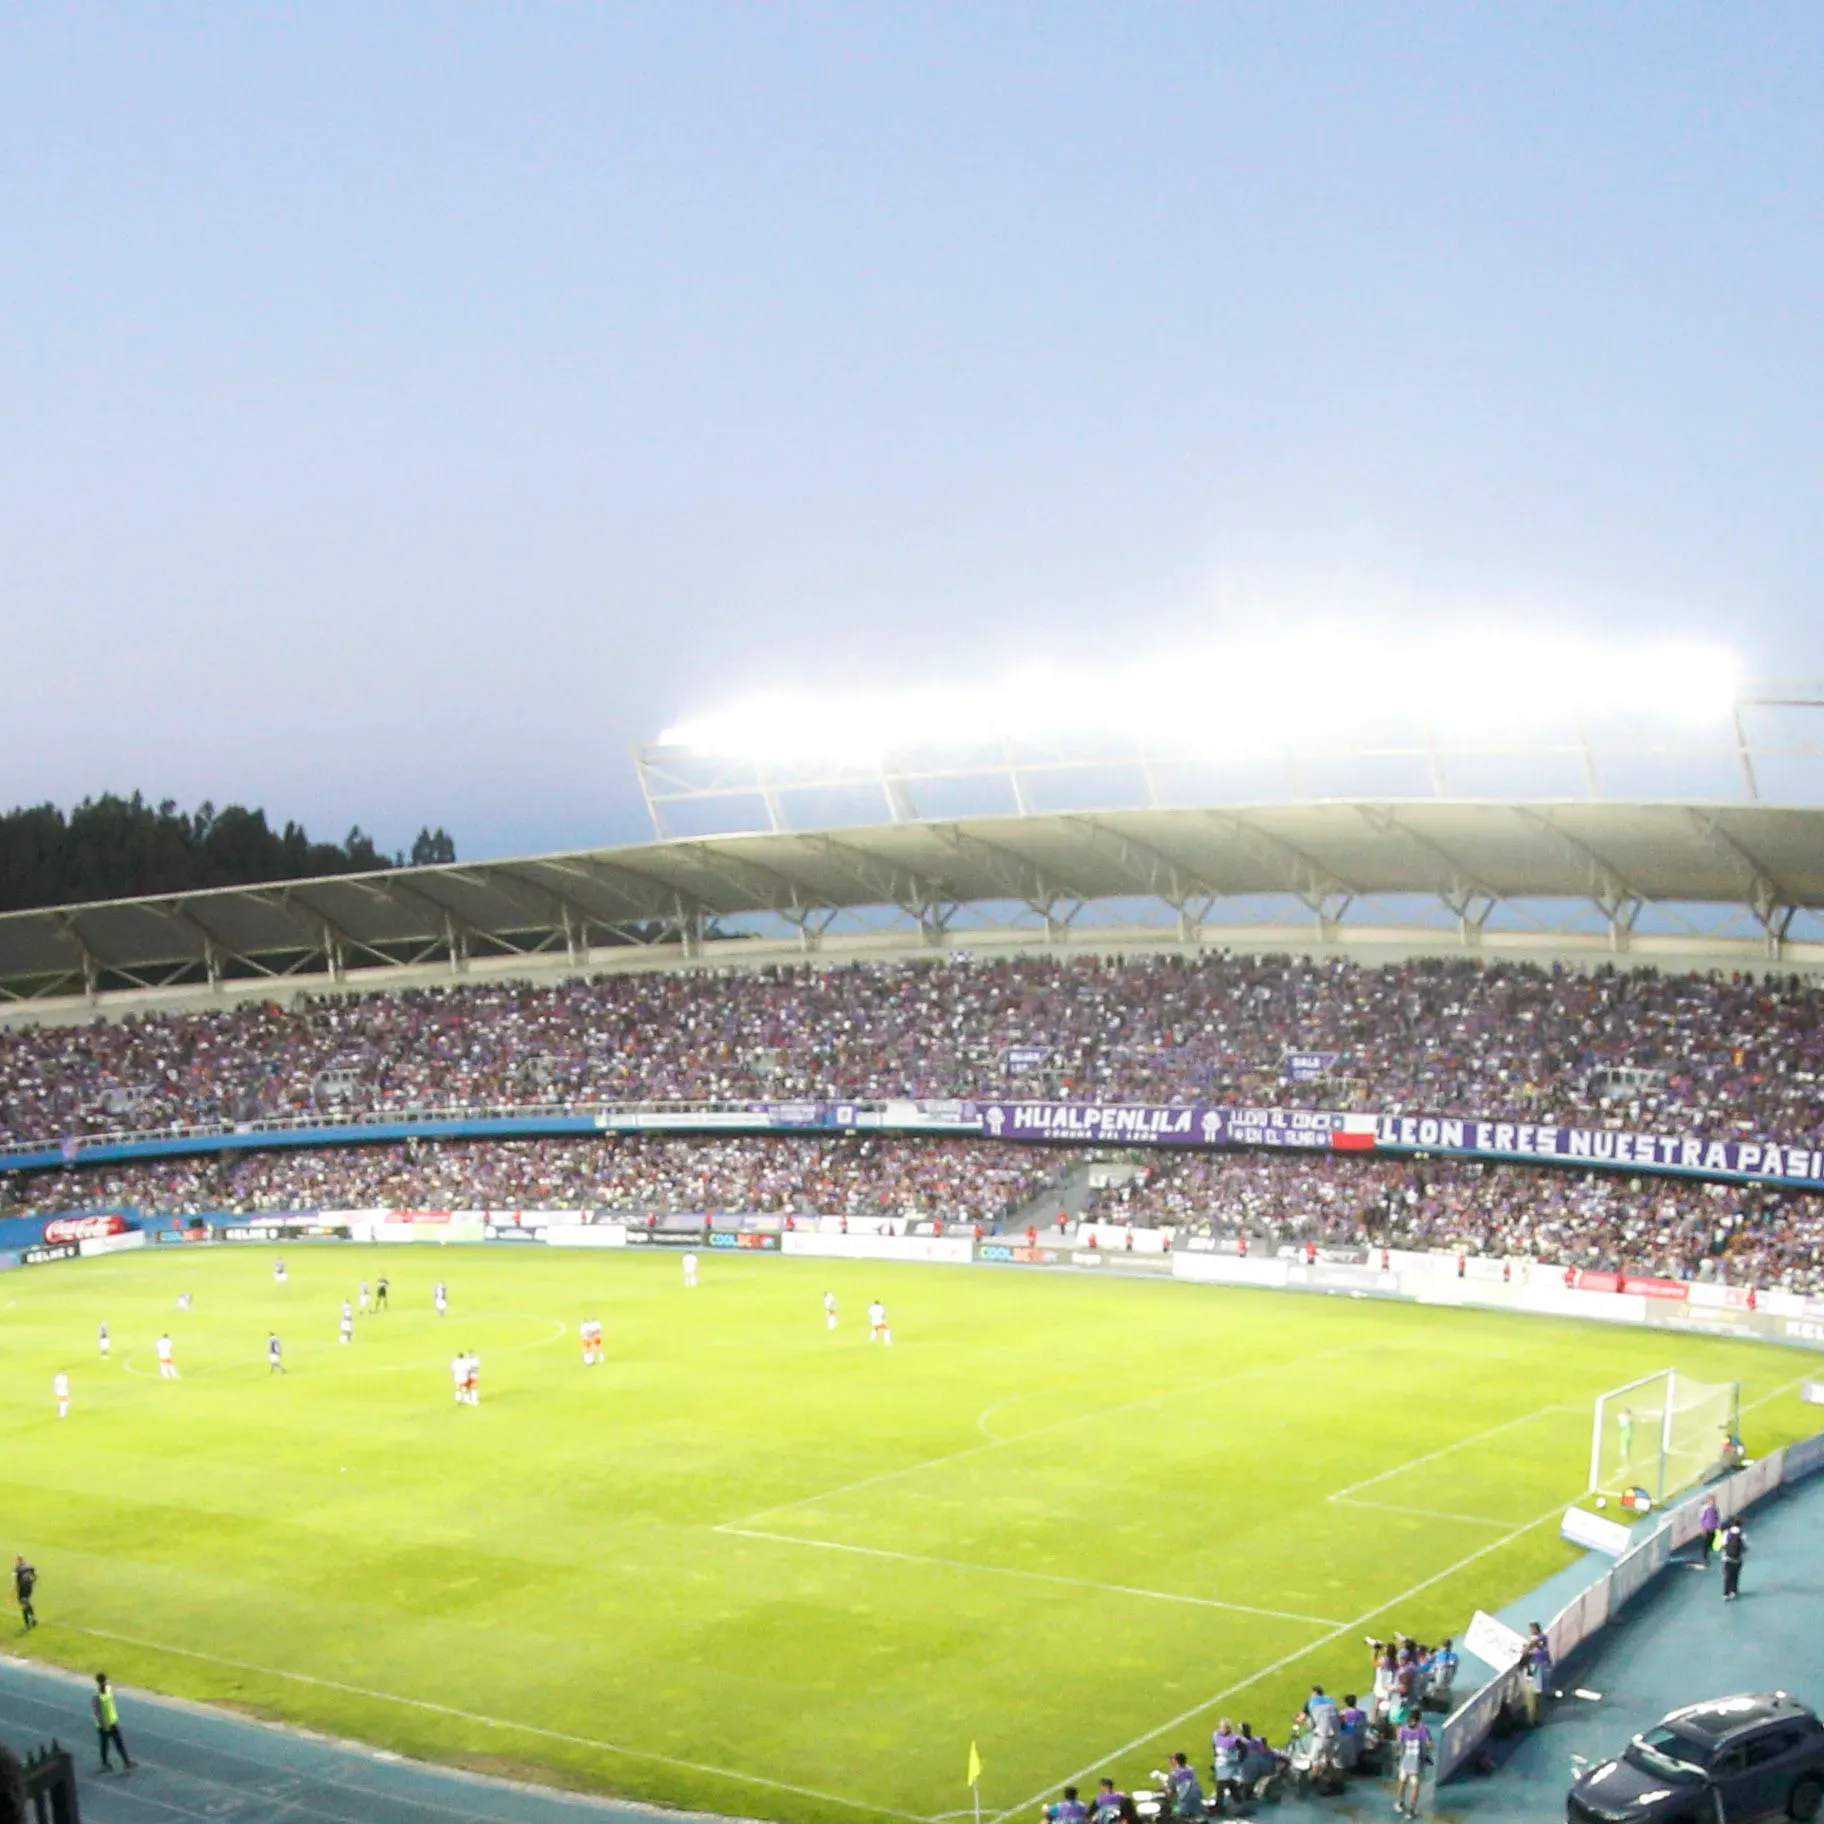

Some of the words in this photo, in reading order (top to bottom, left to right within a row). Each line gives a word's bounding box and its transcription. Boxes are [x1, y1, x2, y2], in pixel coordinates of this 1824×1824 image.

[1013, 1107, 1192, 1132] HUALPENLILA
[1383, 1116, 1463, 1147] LEON
[1477, 1121, 1557, 1151] ERES
[1569, 1129, 1727, 1170] NUESTRA
